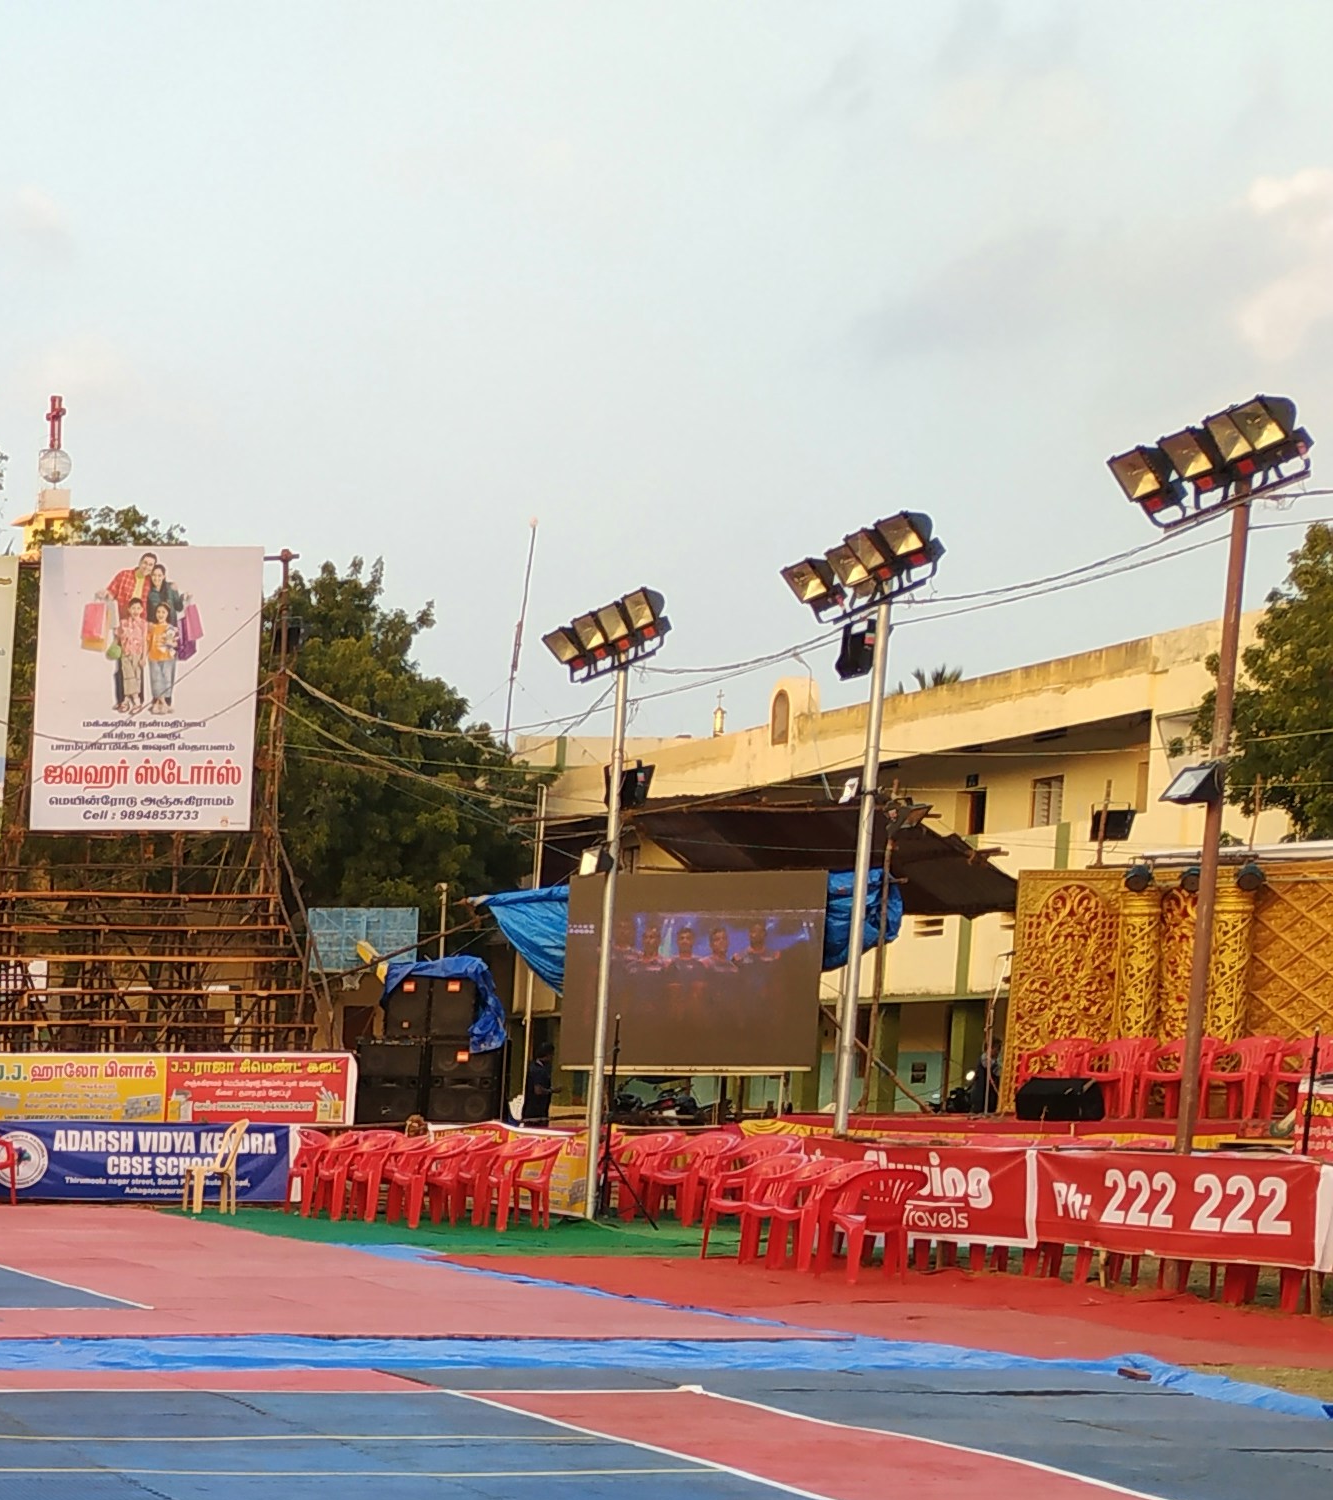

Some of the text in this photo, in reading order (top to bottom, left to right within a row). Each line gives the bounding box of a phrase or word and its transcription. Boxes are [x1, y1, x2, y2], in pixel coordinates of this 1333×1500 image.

[43, 758, 241, 791] ஜவஹர் ஸ்டோர்ஸ்
[49, 795, 234, 807] மெயின்ரோடு அஞ்சுகிராமம்
[83, 810, 199, 820] Cell 9894853733
[53, 1130, 196, 1153] ADARSH VIDYA
[106, 1156, 151, 1176] CBSE
[1052, 1168, 1292, 1235] Ph: 222 222
[904, 1206, 969, 1229] Travels
